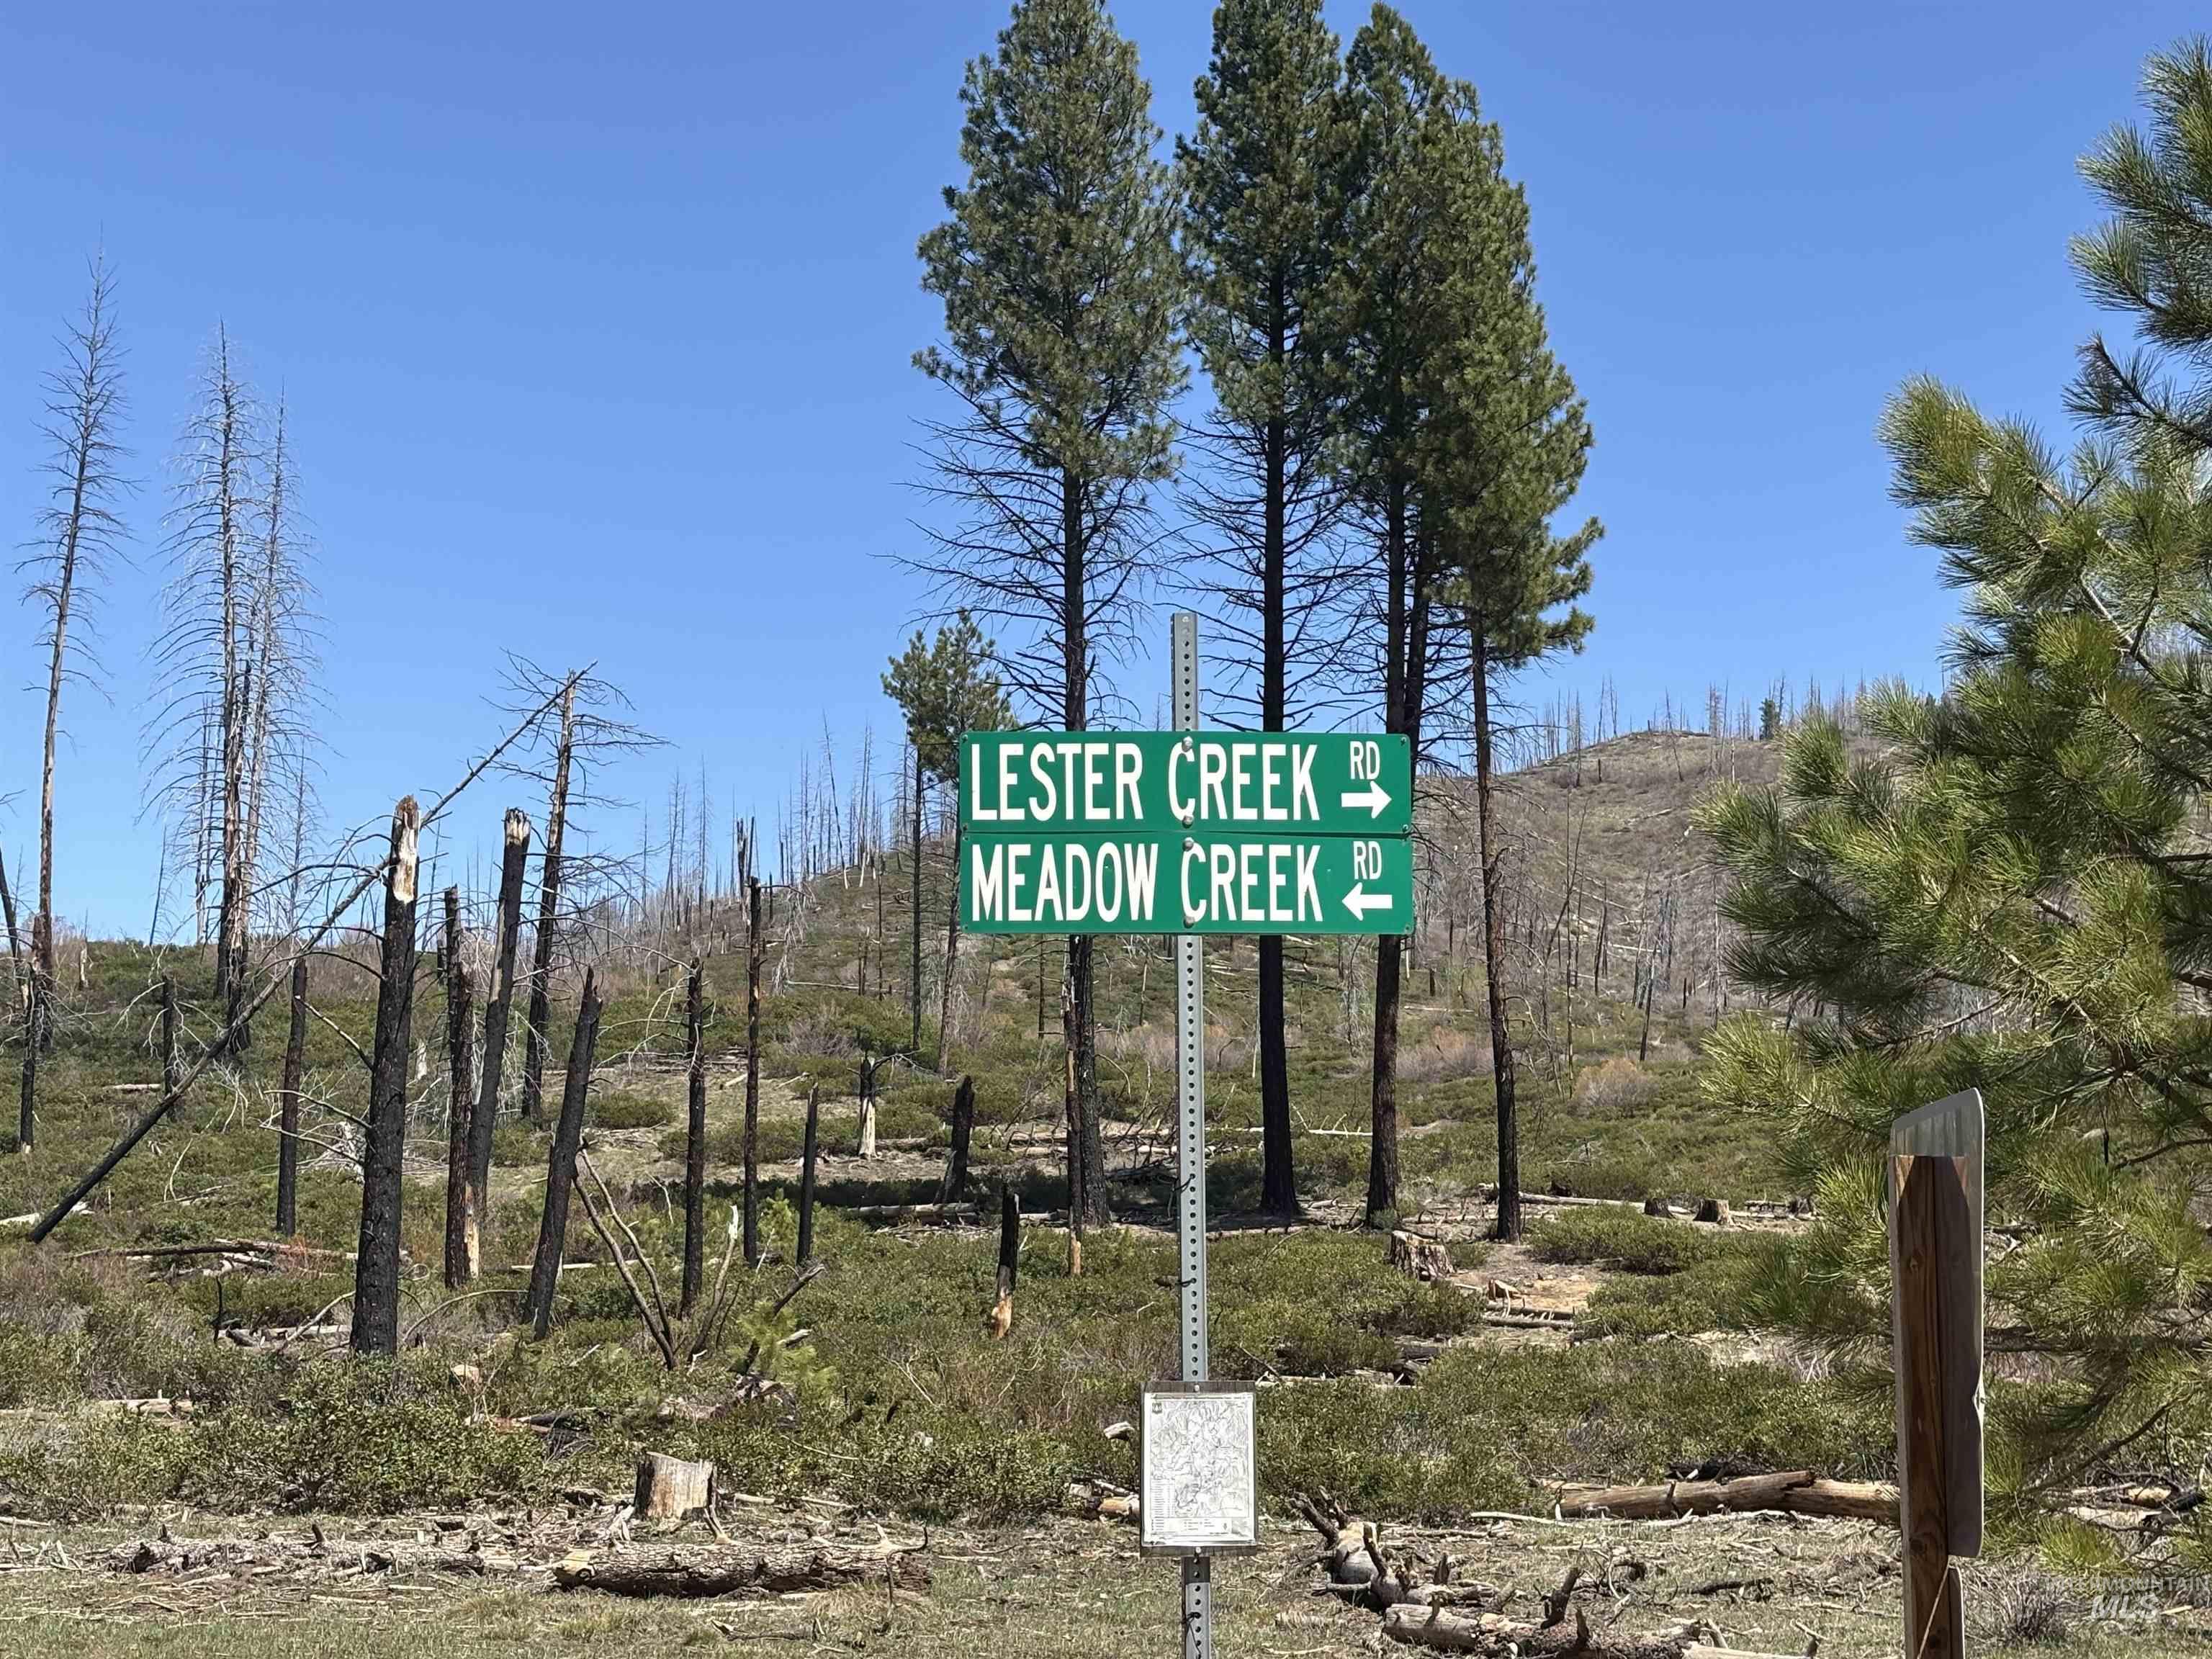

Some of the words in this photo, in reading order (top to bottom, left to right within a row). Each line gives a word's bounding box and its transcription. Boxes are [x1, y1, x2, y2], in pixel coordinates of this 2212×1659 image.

[971, 742, 1143, 821] LESTER
[1168, 742, 1321, 822] CREEK
[1350, 741, 1380, 780] RD
[972, 842, 1159, 922] MEADOW
[1181, 842, 1323, 922] CREEK
[1353, 841, 1382, 880] RD
